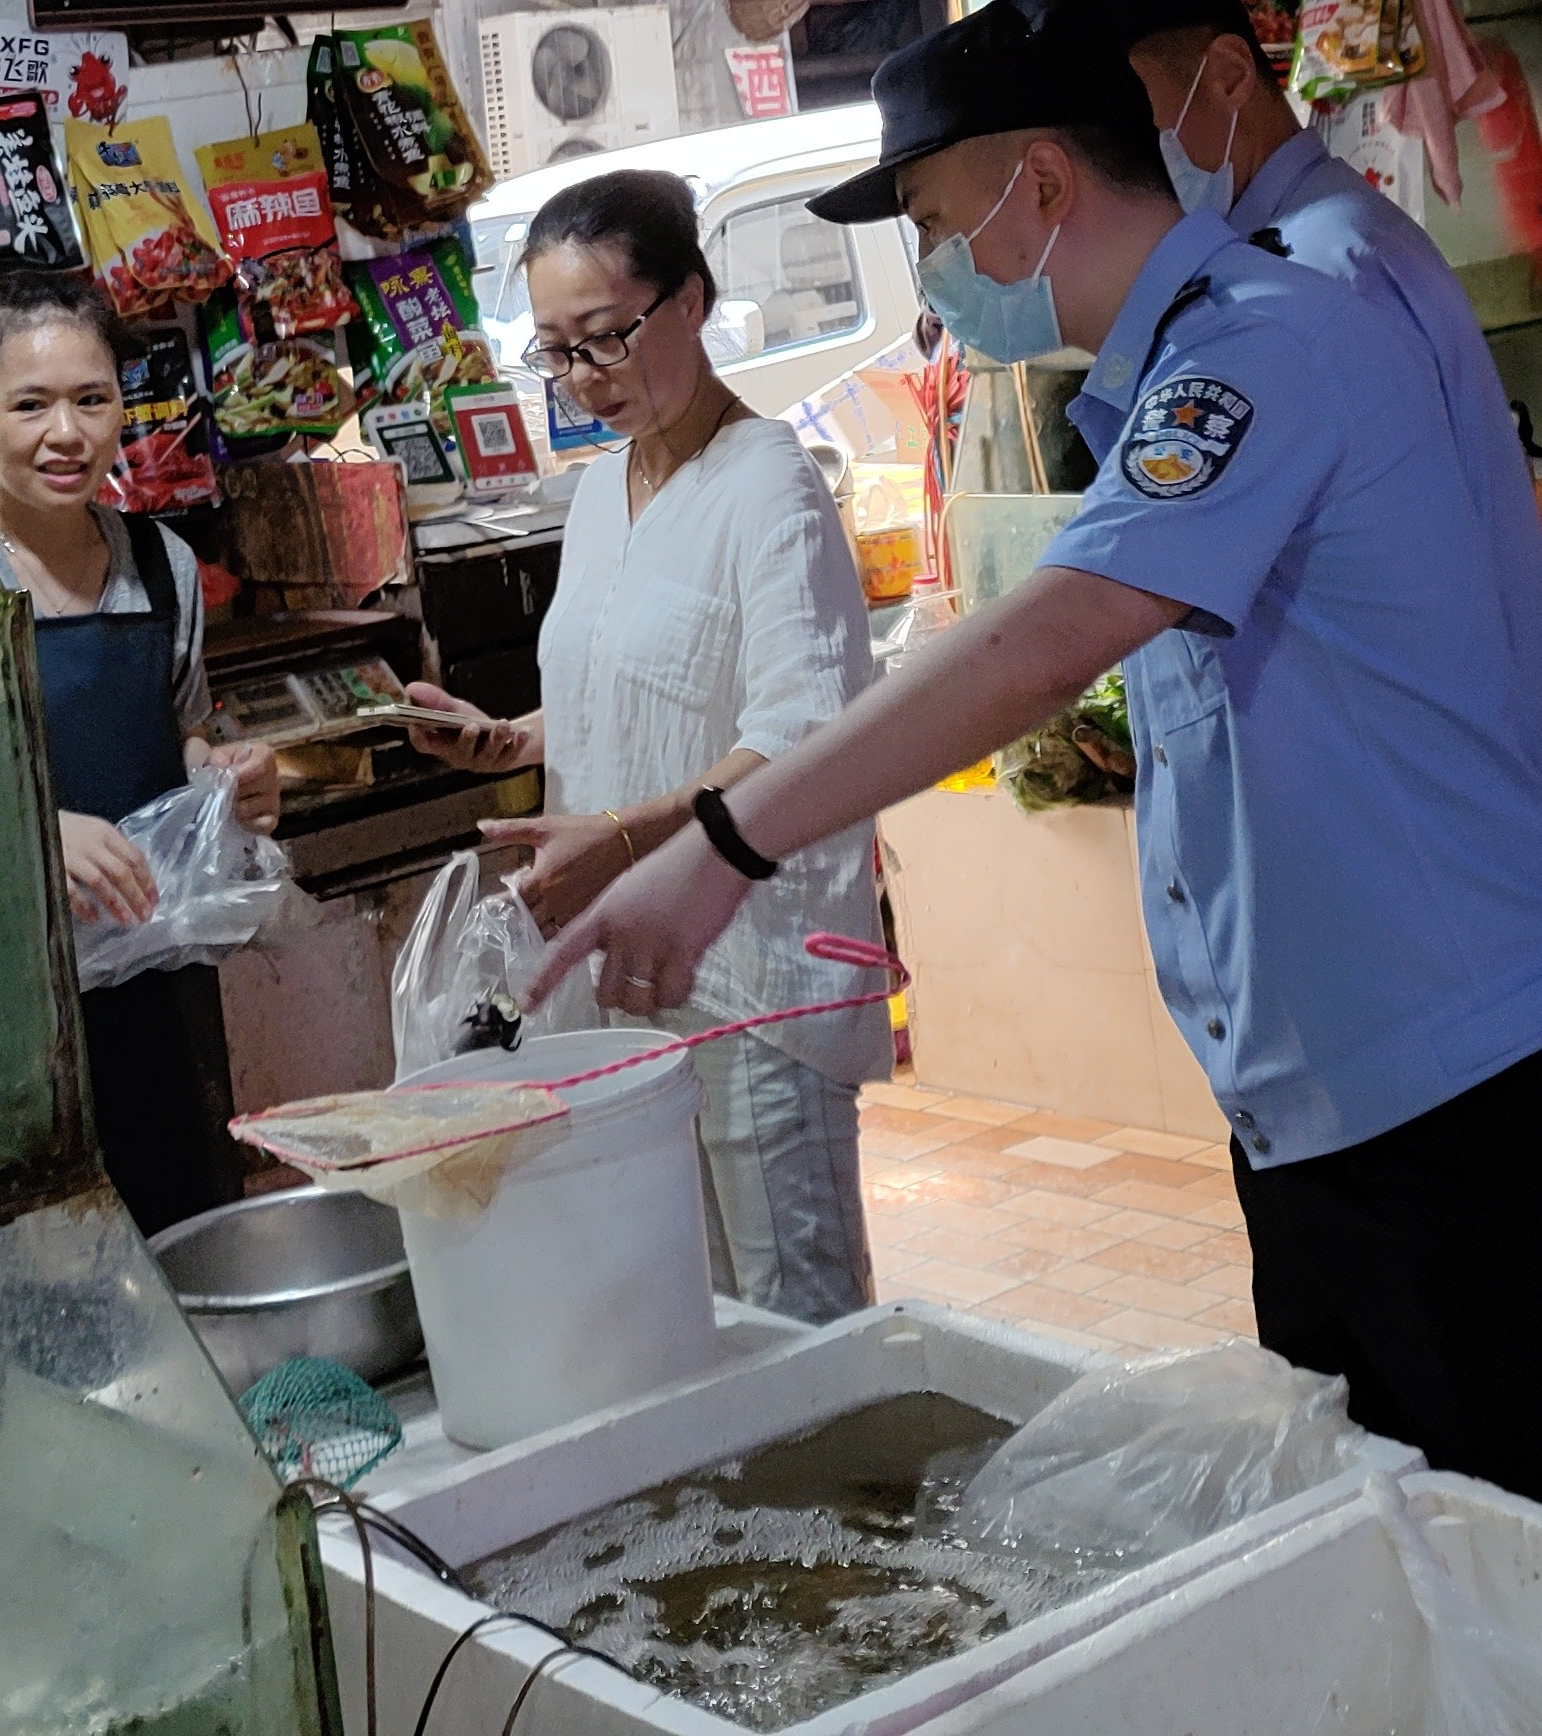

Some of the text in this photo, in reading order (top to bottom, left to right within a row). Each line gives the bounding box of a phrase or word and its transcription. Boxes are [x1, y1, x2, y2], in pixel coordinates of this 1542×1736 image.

[0, 36, 50, 56] XFG
[225, 187, 323, 232] 麻辣鱼
[395, 296, 444, 366] 酸菜鱼
[1144, 381, 1252, 421] 中华人民共和国
